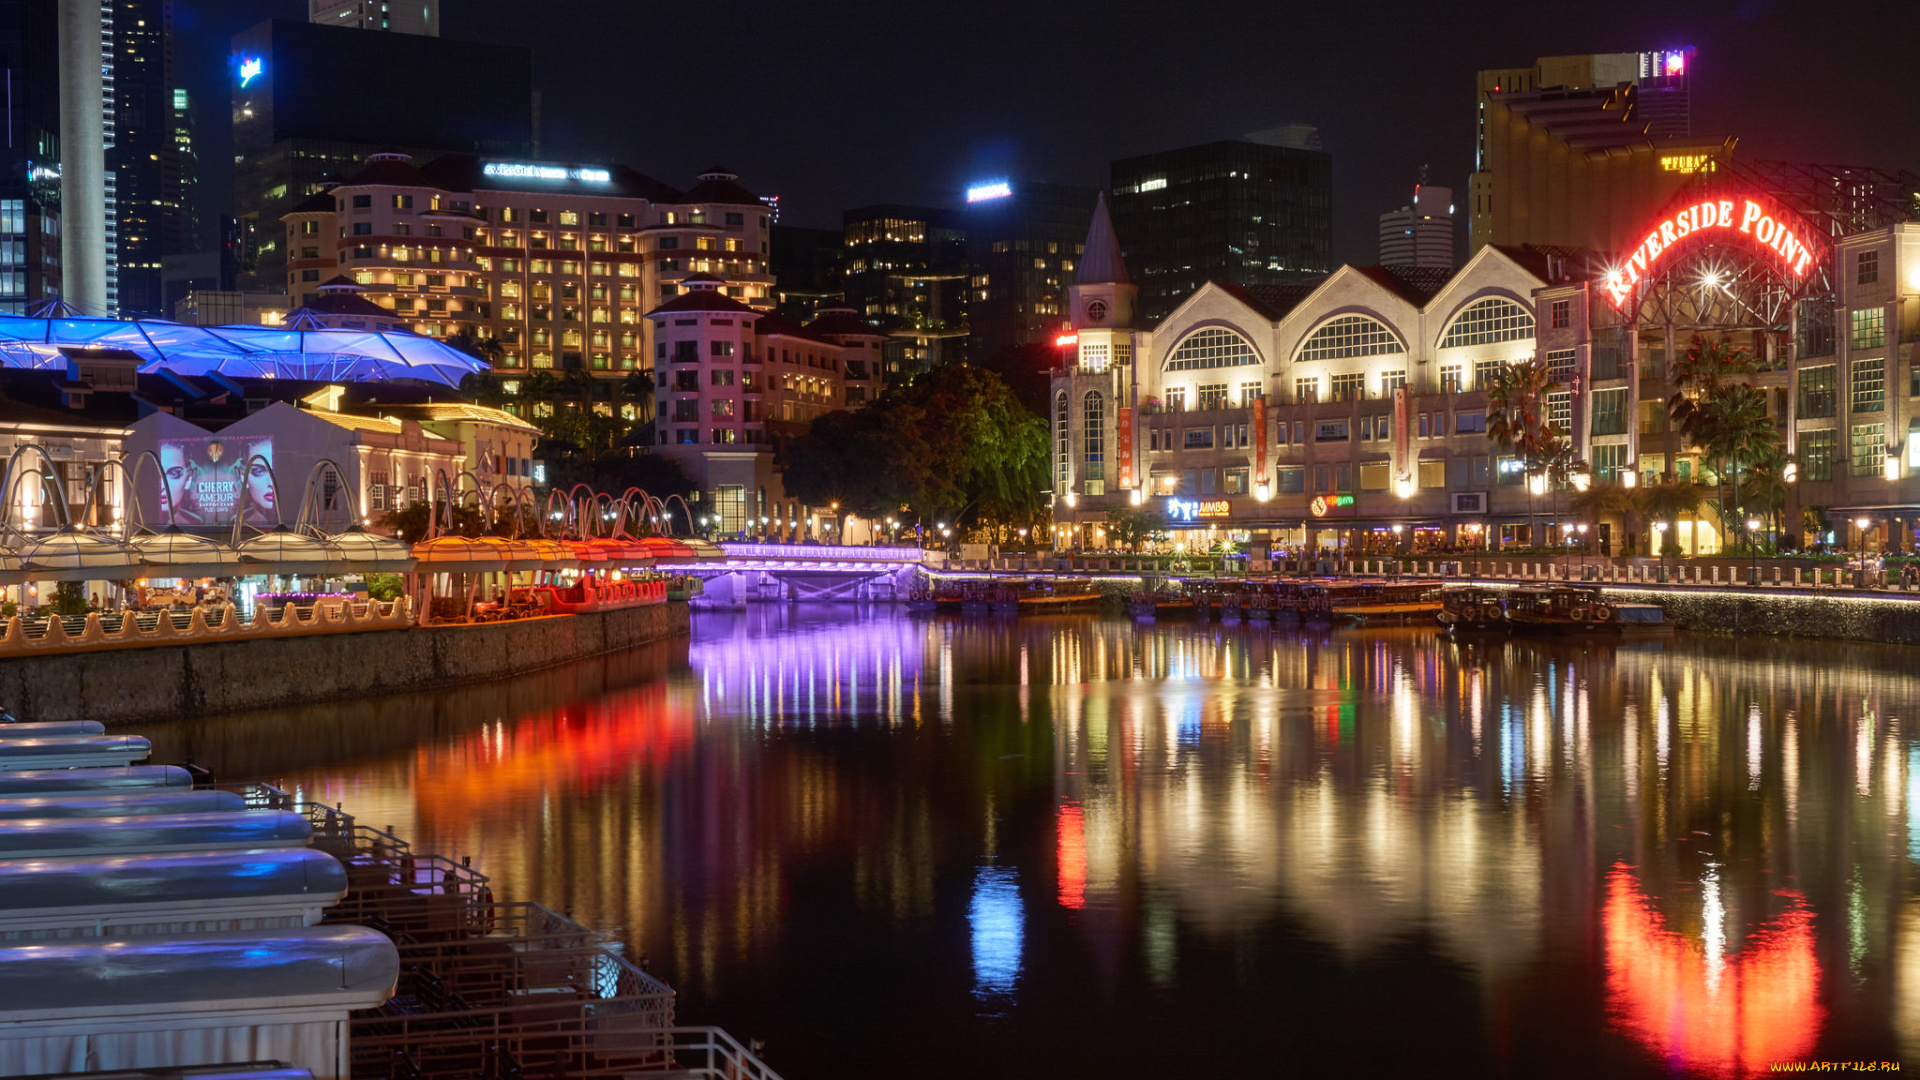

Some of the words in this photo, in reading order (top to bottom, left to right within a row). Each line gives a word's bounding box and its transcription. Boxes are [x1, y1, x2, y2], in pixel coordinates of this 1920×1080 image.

[1606, 201, 1733, 306] RIVERSIDE
[1740, 200, 1811, 276] POINT
[199, 481, 234, 493] CHERRY
[199, 493, 234, 502] AMOUR
[1199, 500, 1229, 513] JUMBO
